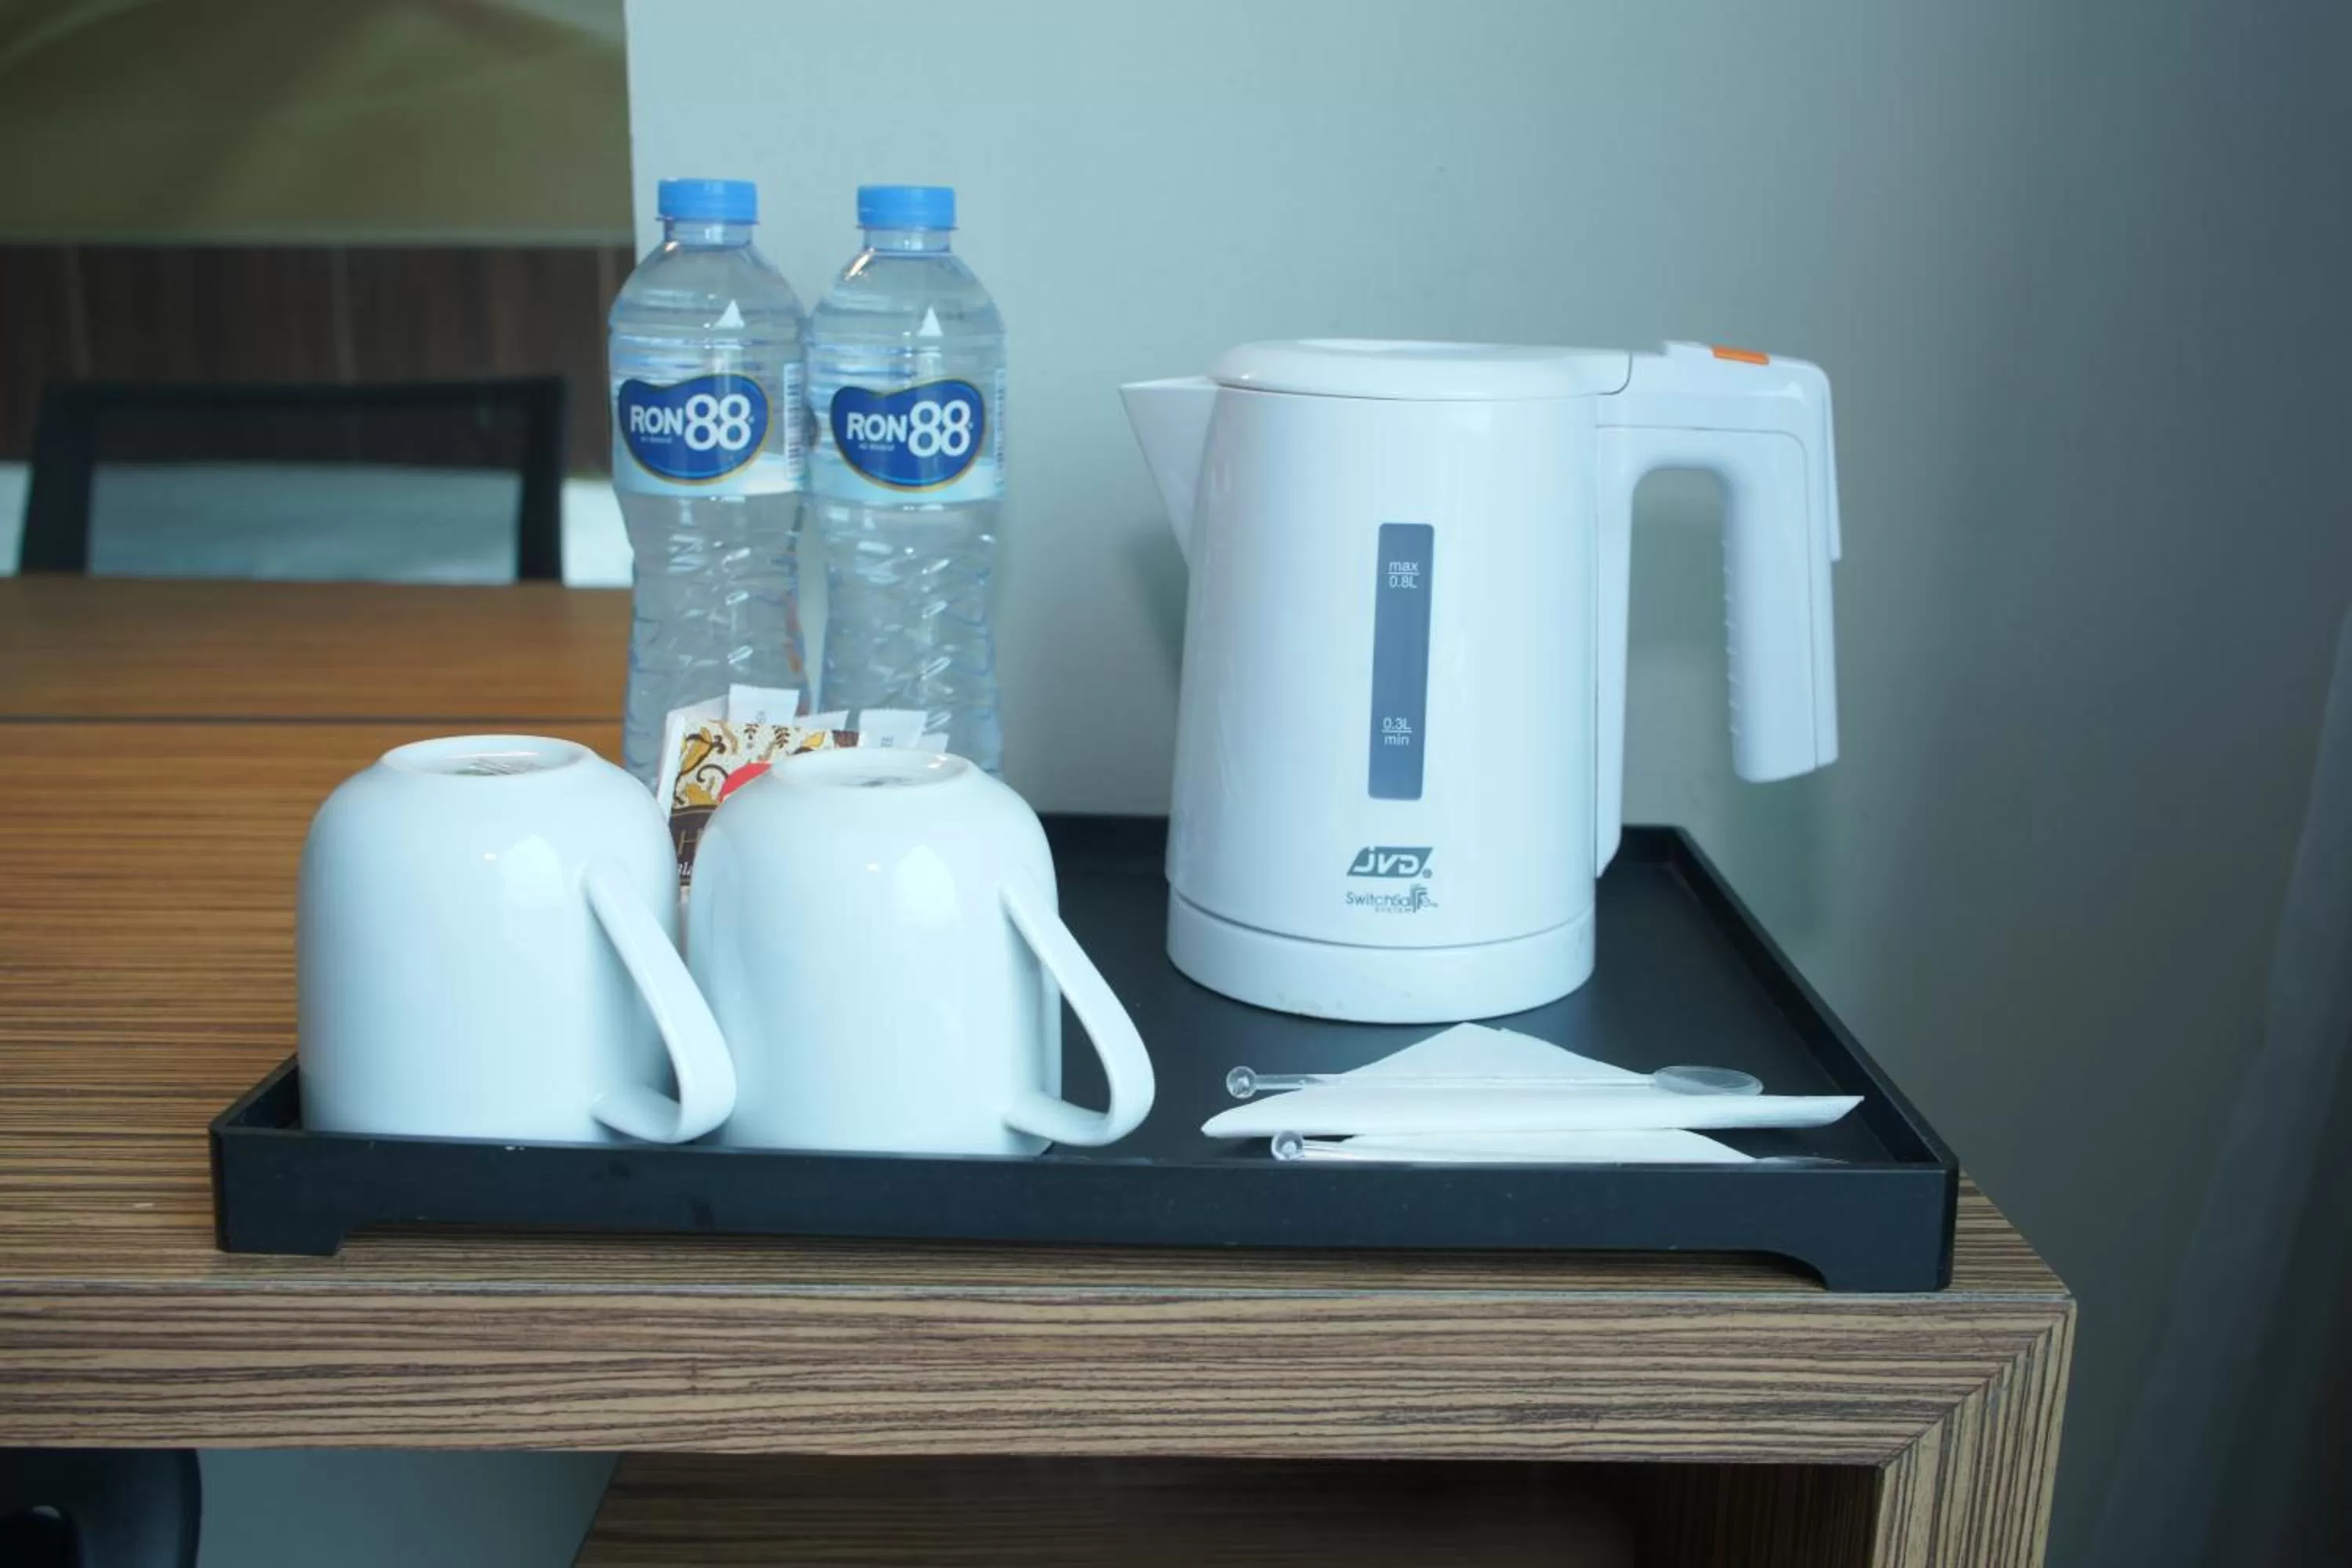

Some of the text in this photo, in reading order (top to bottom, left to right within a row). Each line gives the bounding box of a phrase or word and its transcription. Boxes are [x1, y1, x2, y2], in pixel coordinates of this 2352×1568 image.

[1388, 561, 1418, 572] max
[1388, 575, 1418, 589] 0.8L
[1382, 717, 1411, 730] 0.3L
[1384, 733, 1410, 746] min
